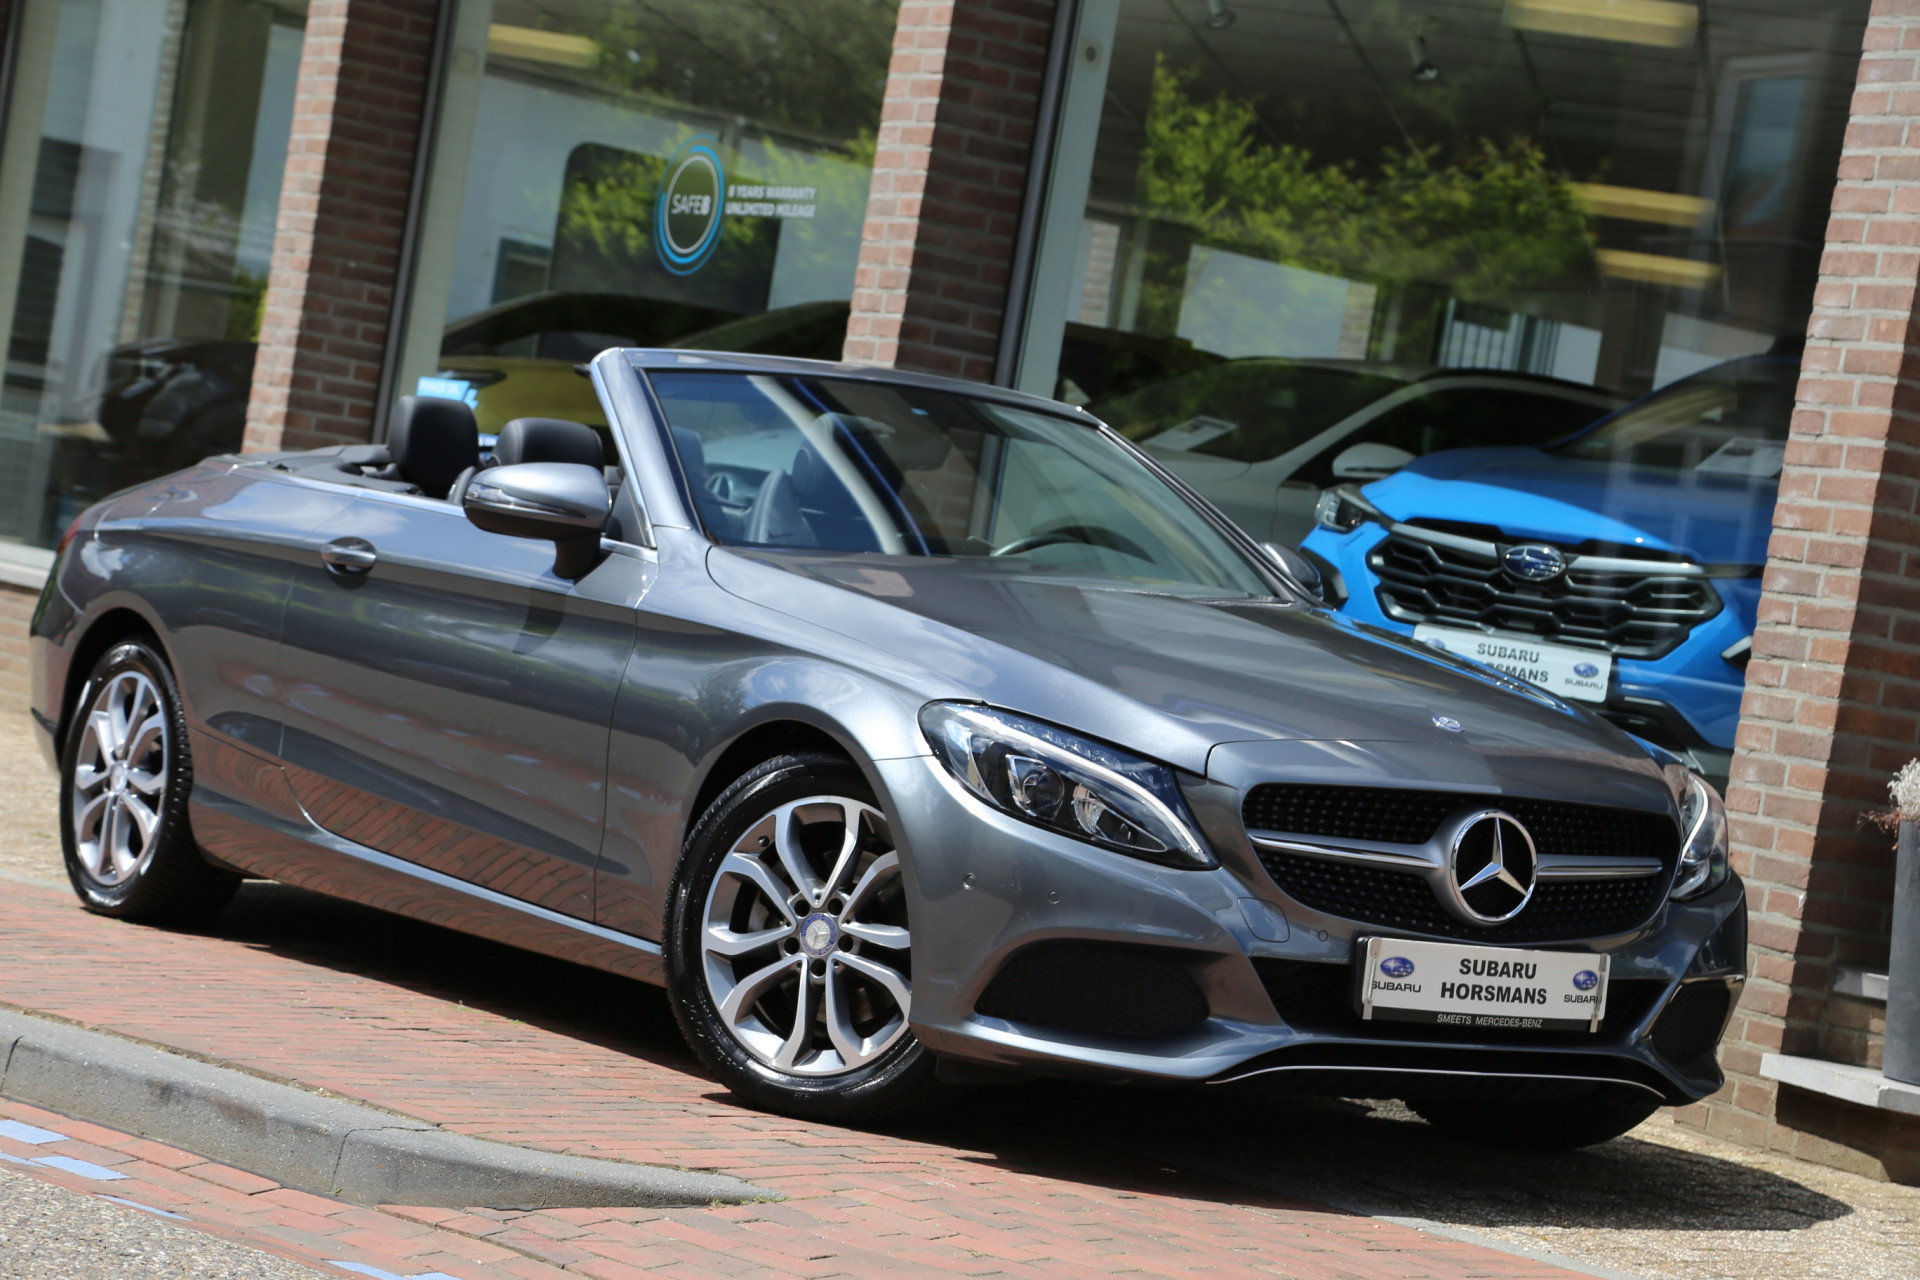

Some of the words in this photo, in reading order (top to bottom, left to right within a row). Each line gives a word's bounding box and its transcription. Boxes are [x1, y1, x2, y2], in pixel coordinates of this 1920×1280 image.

[737, 185, 765, 199] YEARS
[766, 186, 816, 200] WARRANTY
[726, 202, 775, 216] UNLIMITED
[775, 203, 816, 218] MILEAGE
[1477, 643, 1540, 663] SUBARU
[1565, 678, 1604, 690] SUBARU
[1459, 958, 1537, 980] SUBARU
[1372, 980, 1422, 993] SUBARU
[1440, 982, 1547, 1005] HORSMANS
[1437, 1013, 1472, 1025] SMEETS
[1475, 1016, 1543, 1028] MERCEDES-BENZ
